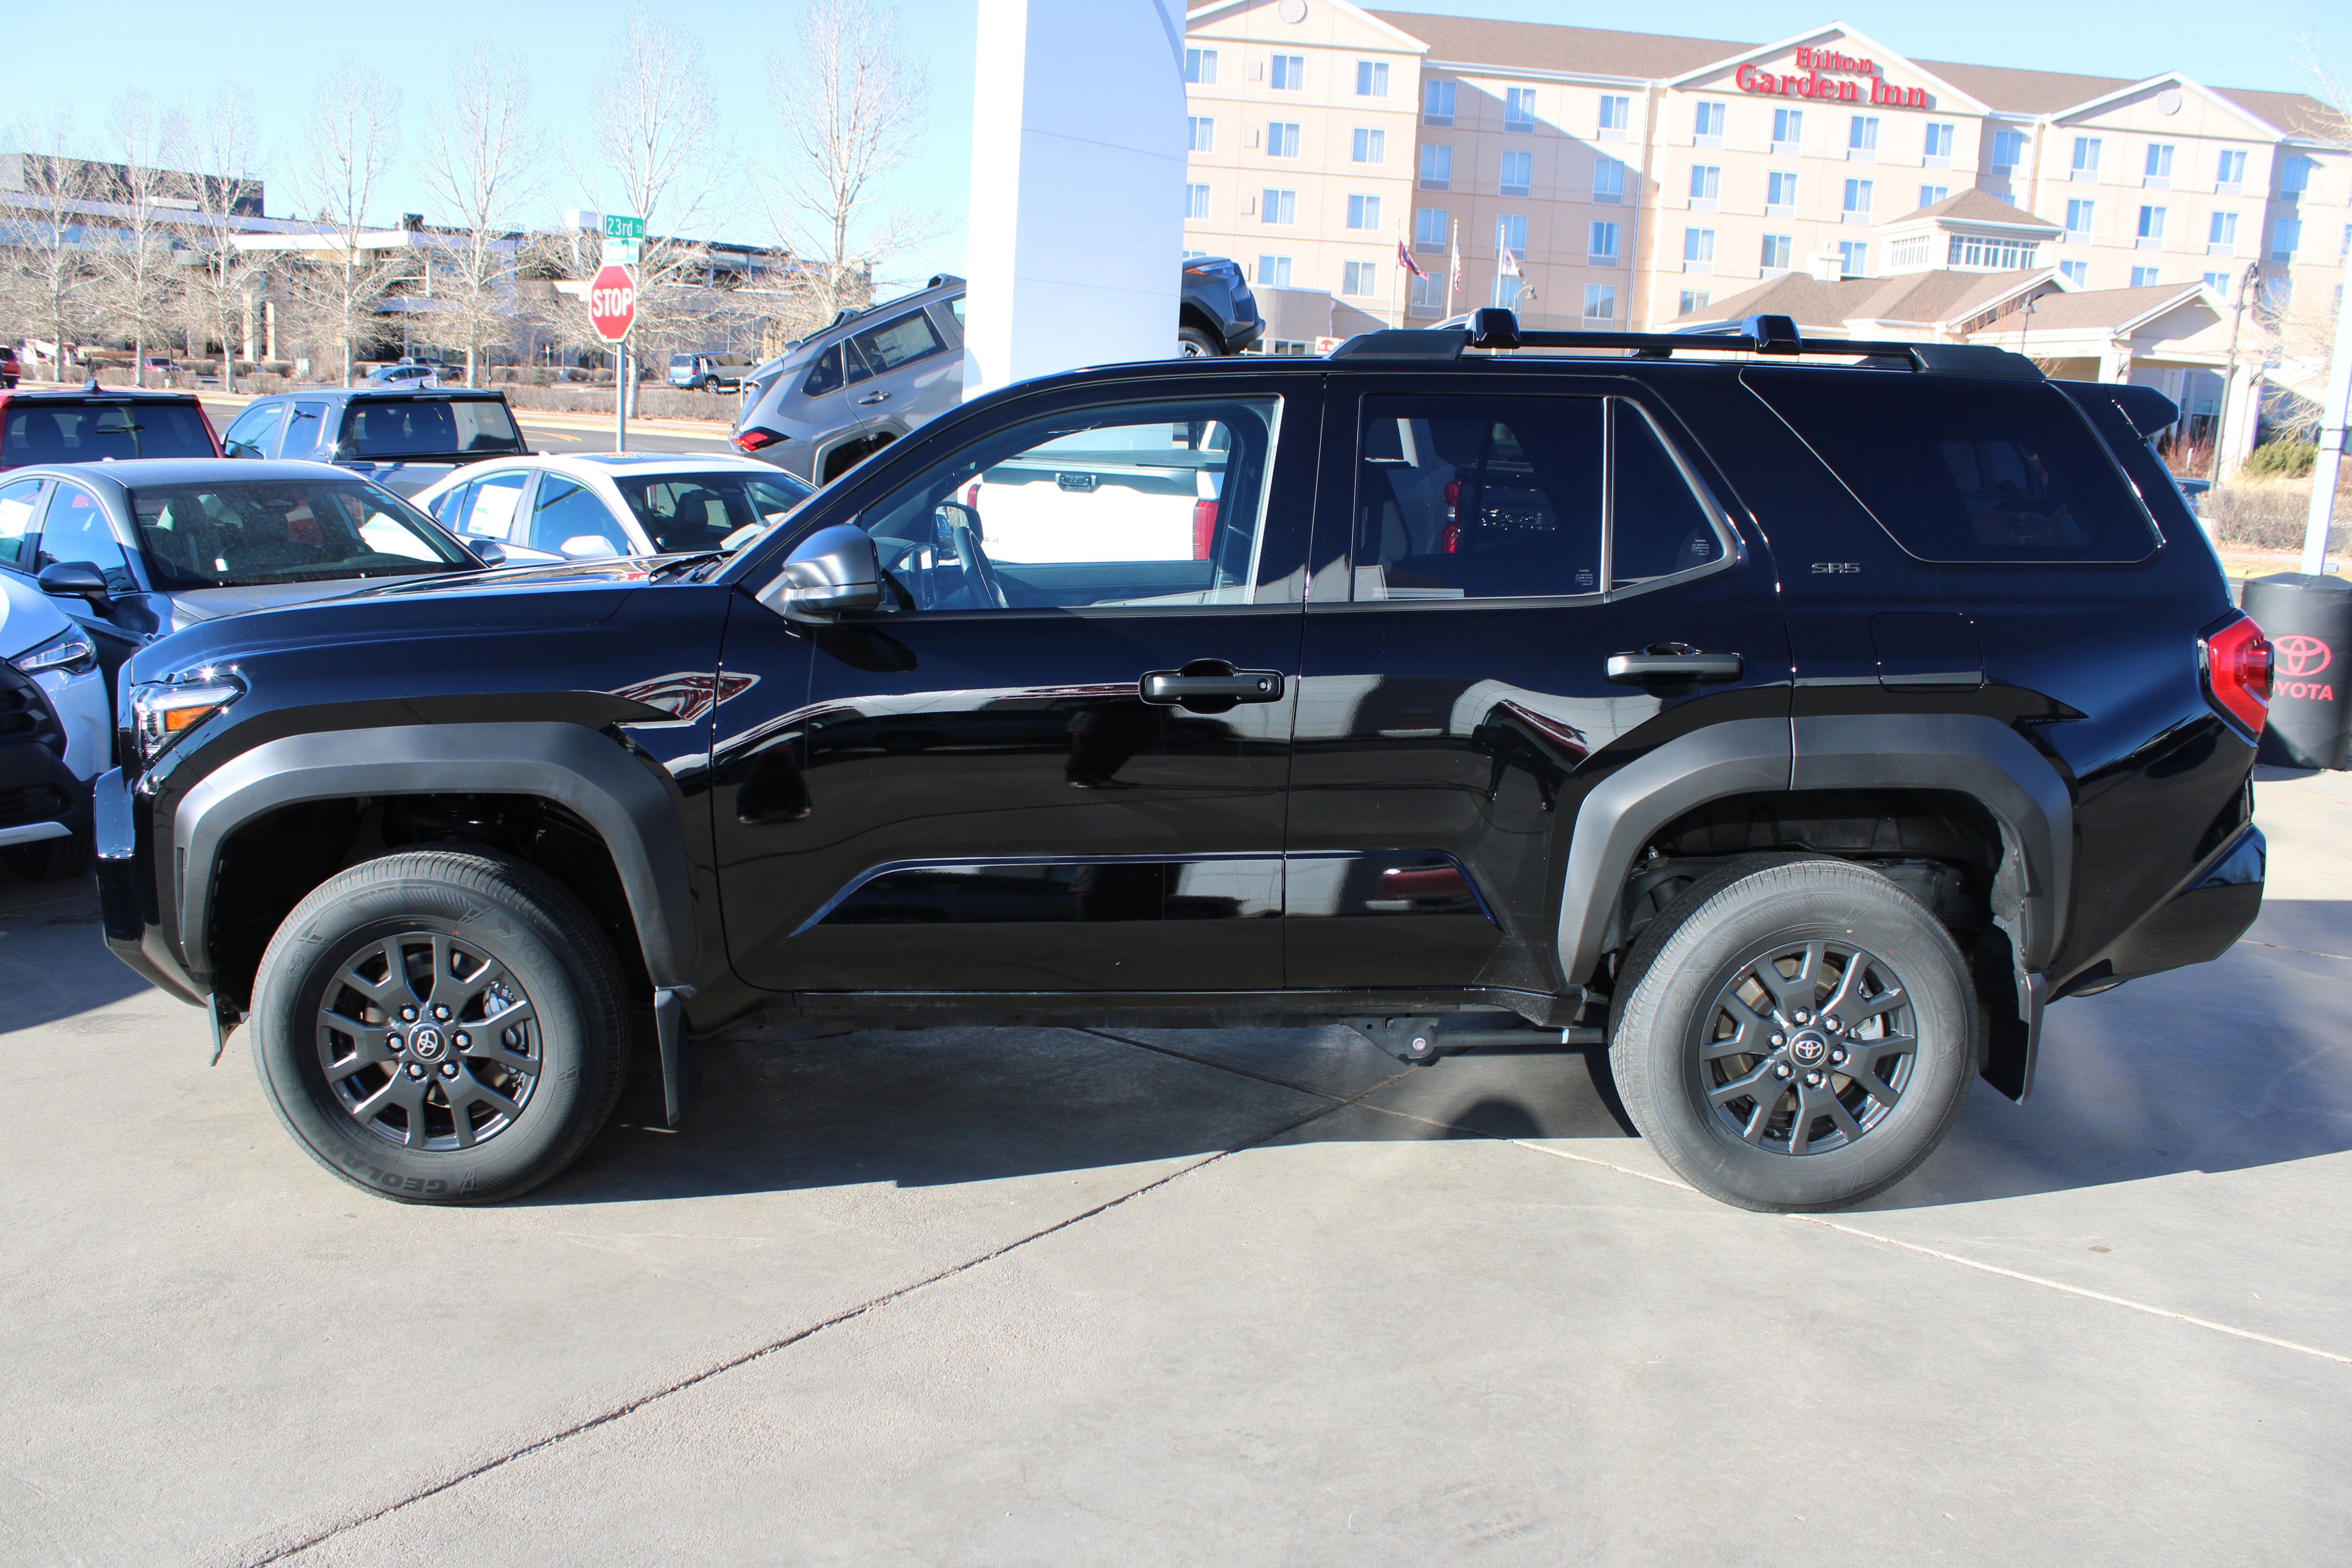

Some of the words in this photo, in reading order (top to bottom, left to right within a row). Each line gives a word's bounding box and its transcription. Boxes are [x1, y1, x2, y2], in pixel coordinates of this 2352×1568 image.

[1795, 46, 1874, 73] Hilton
[1735, 63, 1858, 100] Garden
[1868, 76, 1927, 107] Inn
[607, 217, 633, 236] 23rd
[592, 287, 633, 318] STOP
[1812, 562, 1861, 574] SR5
[2273, 680, 2334, 701] YOTA
